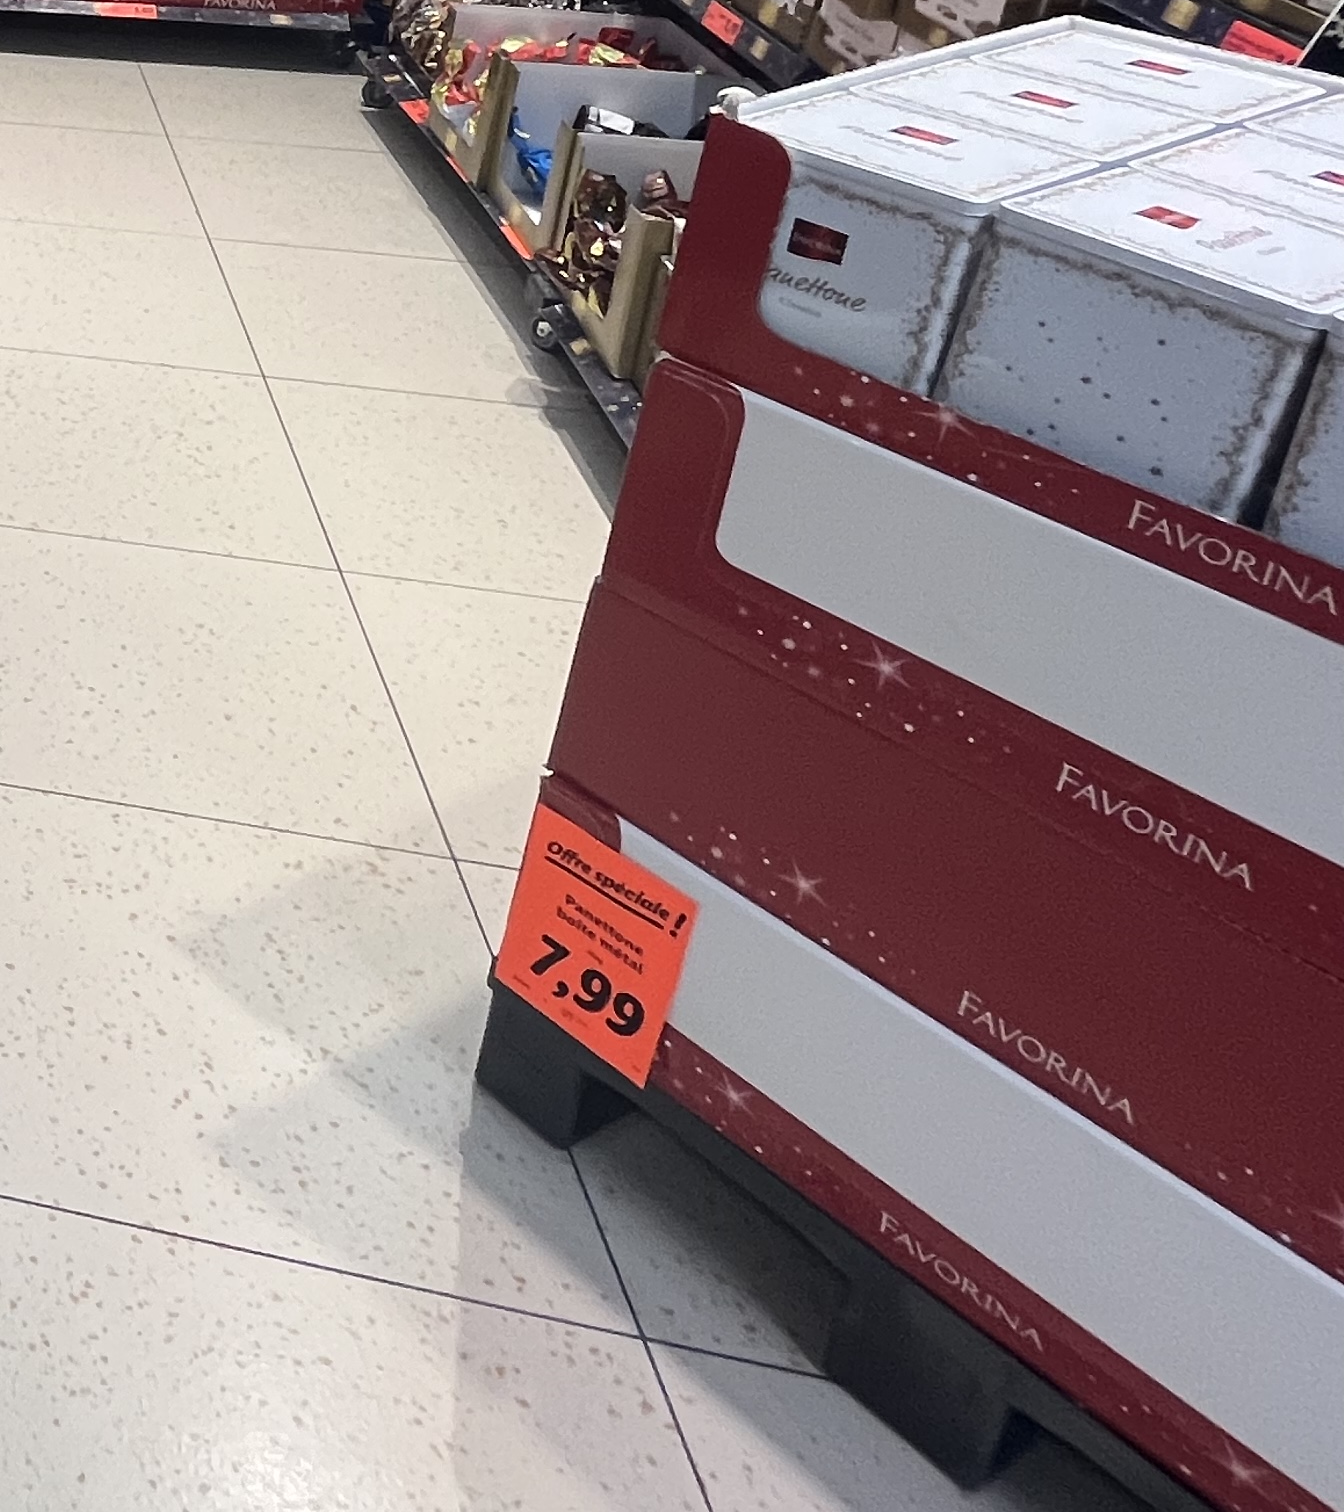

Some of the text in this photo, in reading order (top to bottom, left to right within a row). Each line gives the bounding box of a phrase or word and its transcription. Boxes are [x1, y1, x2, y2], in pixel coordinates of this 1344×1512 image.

[1126, 499, 1339, 616] FAVORINA
[1055, 761, 1254, 891] FAVORINA
[545, 839, 688, 938] Offre spéciale !
[563, 892, 645, 958] Panettone
[528, 933, 646, 1038] 7,99
[956, 990, 1136, 1125] FAVORINA
[879, 1211, 1045, 1352] FAVORINA
